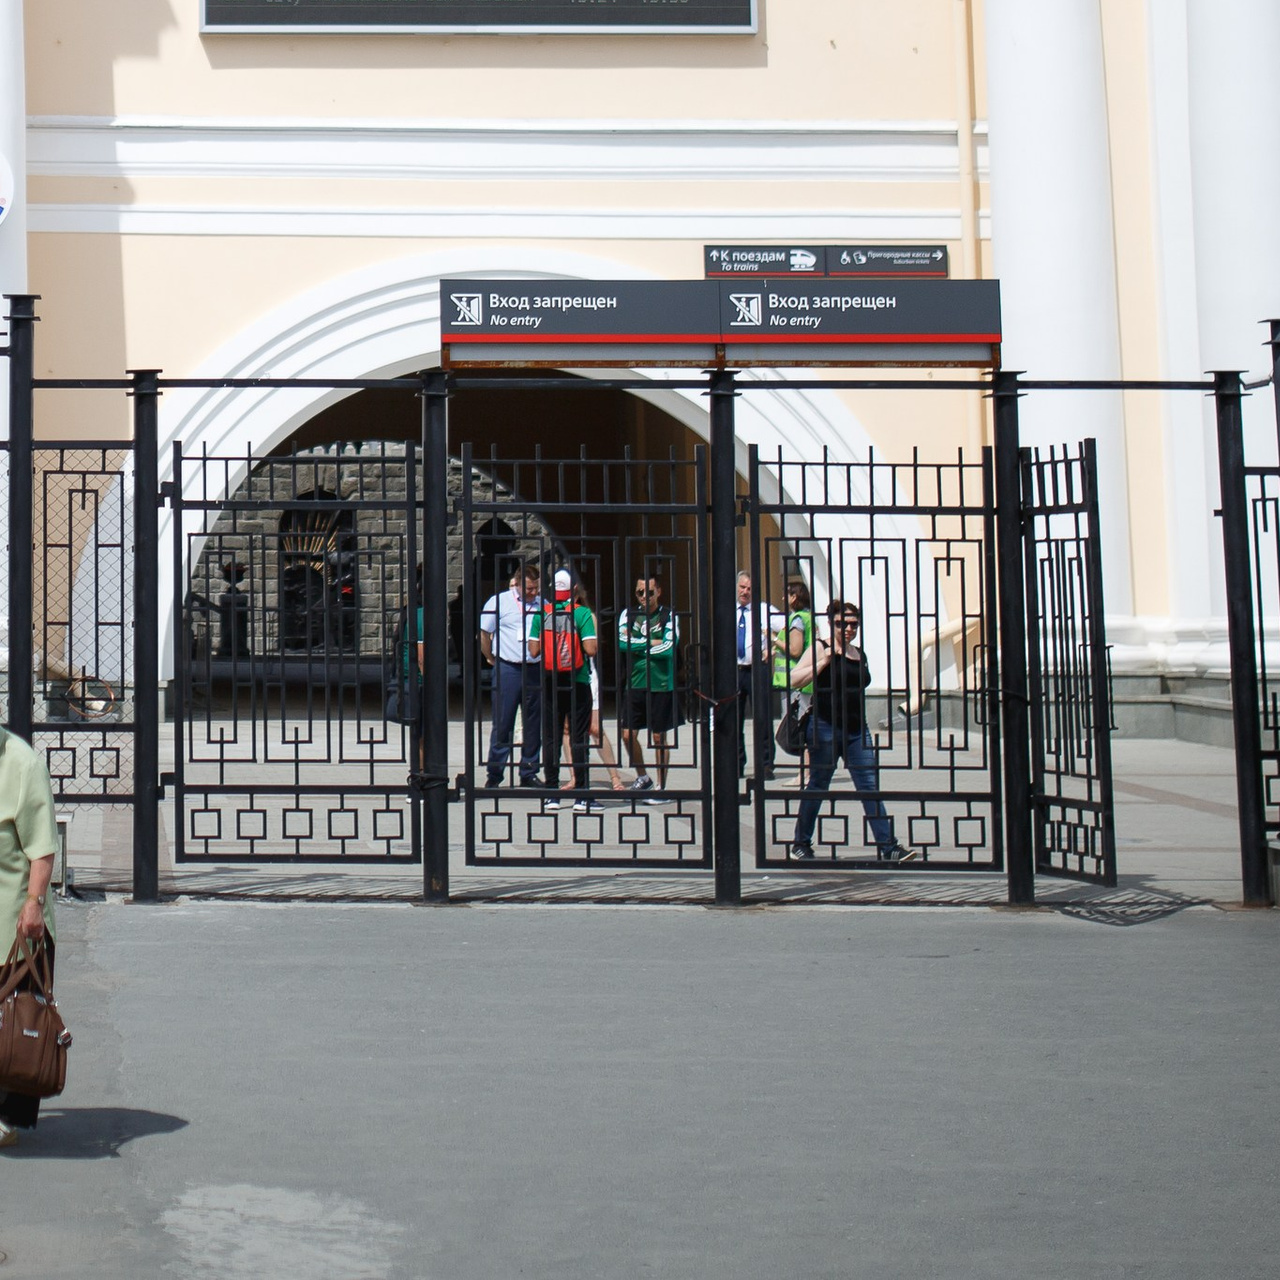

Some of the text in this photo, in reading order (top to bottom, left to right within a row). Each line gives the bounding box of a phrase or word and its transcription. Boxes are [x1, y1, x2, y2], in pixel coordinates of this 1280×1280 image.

[720, 249, 785, 263] К поездам
[721, 262, 759, 271] To trains
[489, 293, 617, 312] Вход запрещен
[769, 293, 896, 312] Вход запрещен
[490, 315, 542, 328] No entry
[770, 315, 822, 328] No entry
